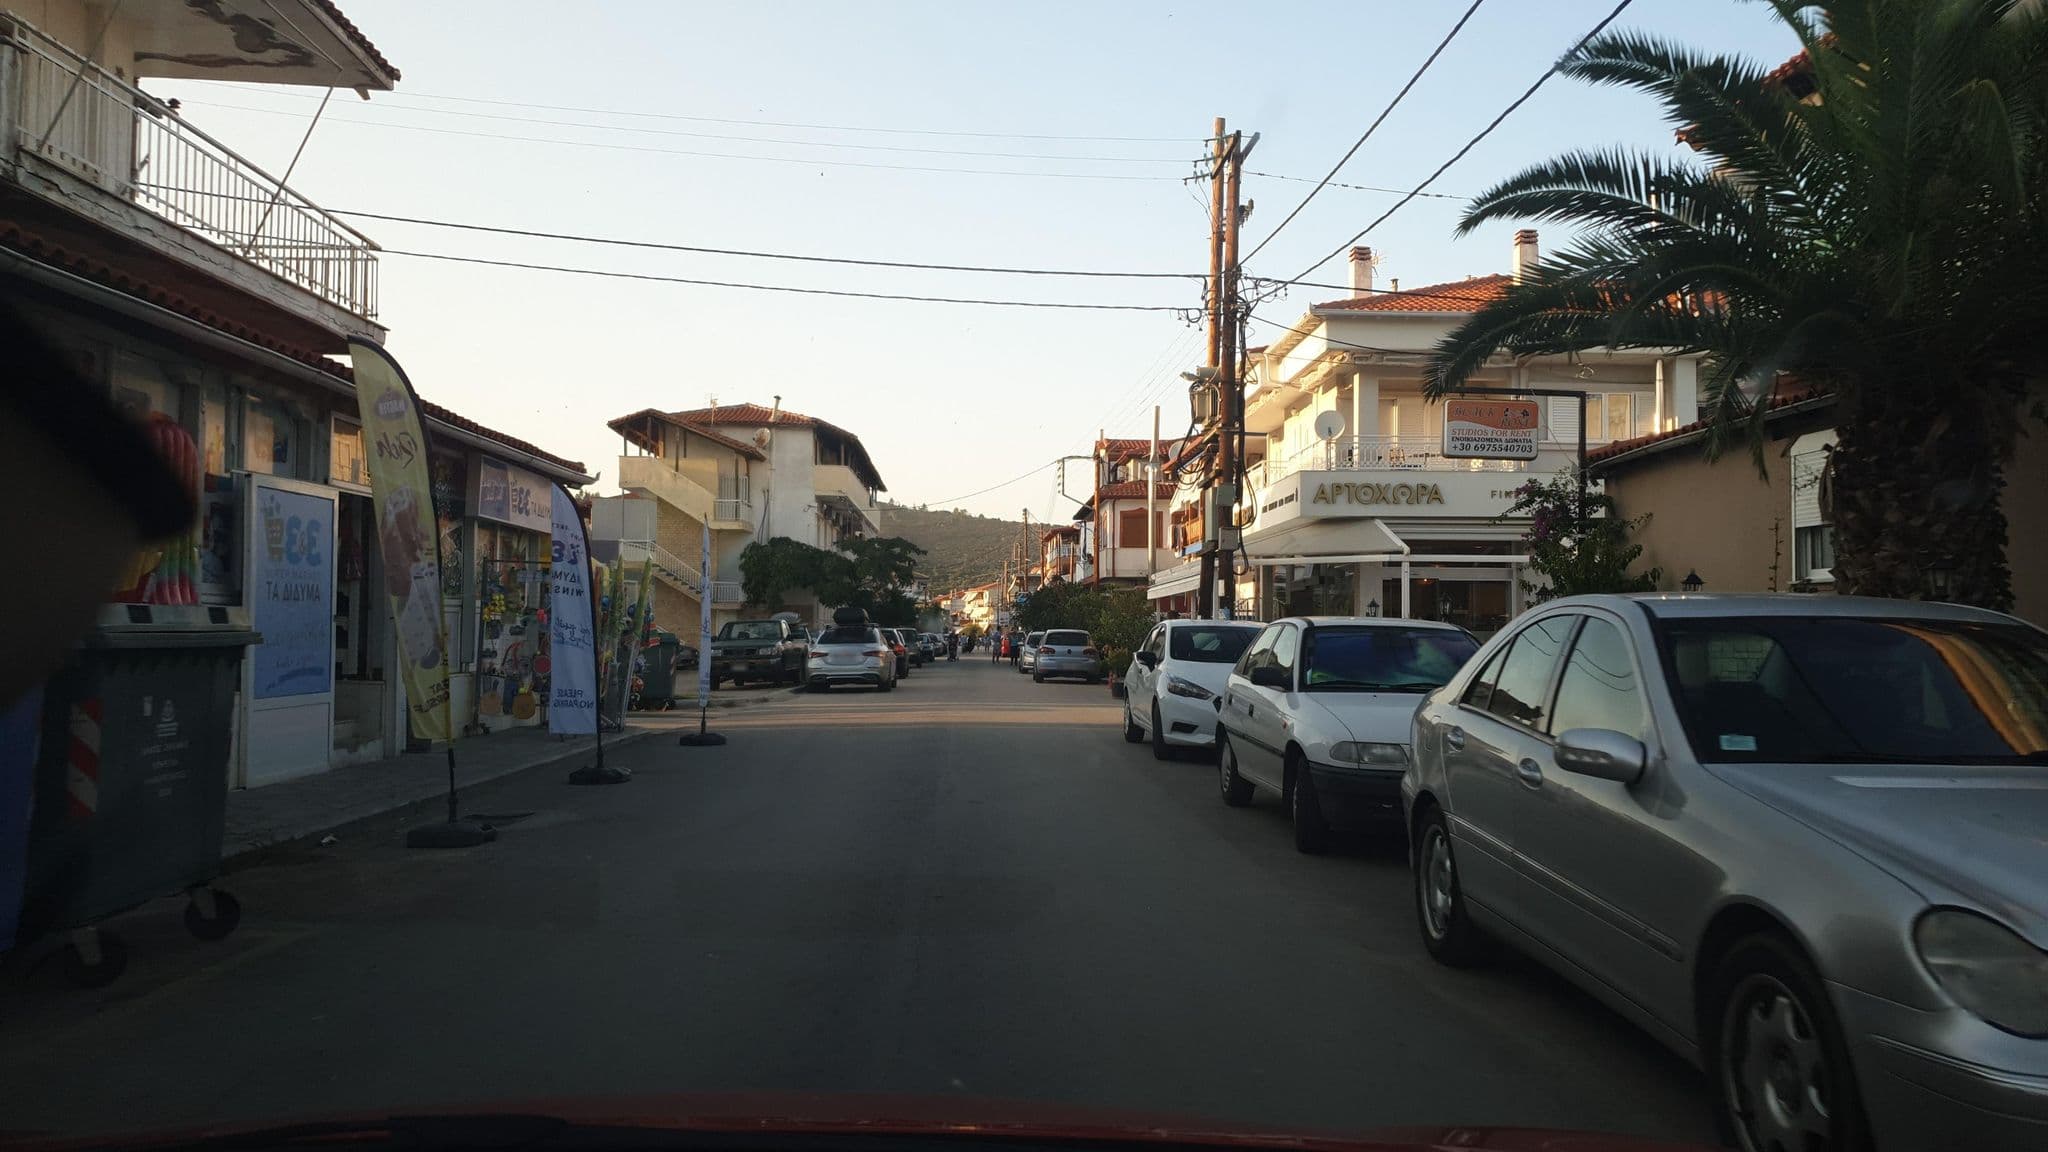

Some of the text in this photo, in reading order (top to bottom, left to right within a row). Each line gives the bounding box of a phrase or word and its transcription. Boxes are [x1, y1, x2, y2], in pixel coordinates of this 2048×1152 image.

[1452, 428, 1489, 437] STUDIOS
[1510, 430, 1532, 438] RENT
[1452, 443, 1533, 453] +30 6975540703
[1313, 482, 1445, 504] ΑΡΤΟΧΩΡΑ
[266, 581, 321, 602] ΤΑ ΔΙΔΥΜΑ
